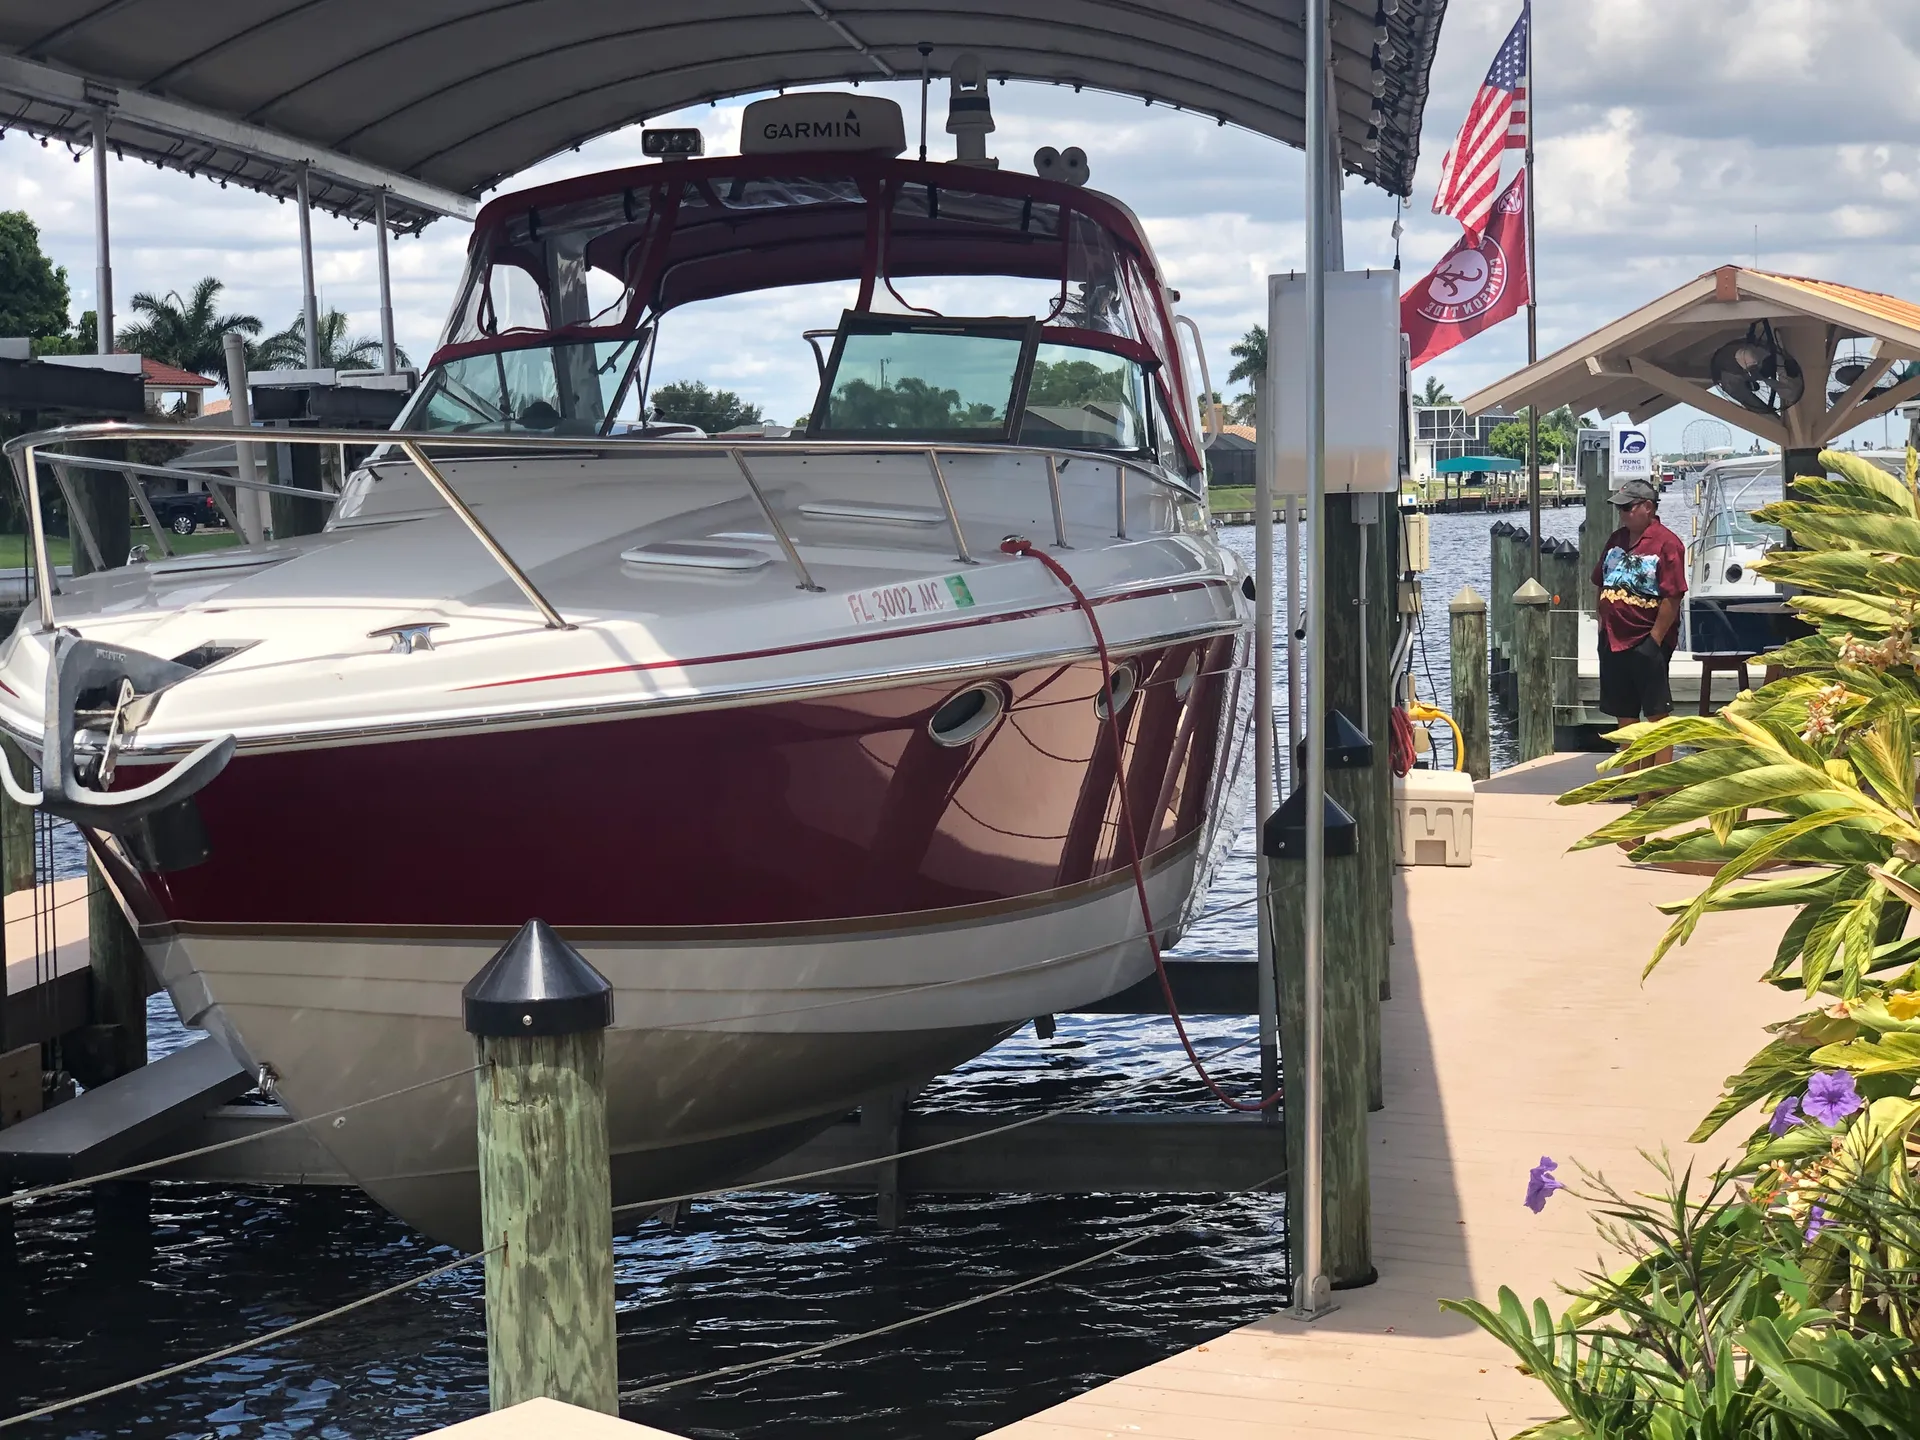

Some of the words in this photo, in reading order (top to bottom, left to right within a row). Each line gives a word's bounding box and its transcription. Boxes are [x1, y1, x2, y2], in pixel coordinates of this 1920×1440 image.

[763, 122, 861, 140] GARMIN
[847, 593, 874, 625] FL
[871, 586, 917, 622] 3002
